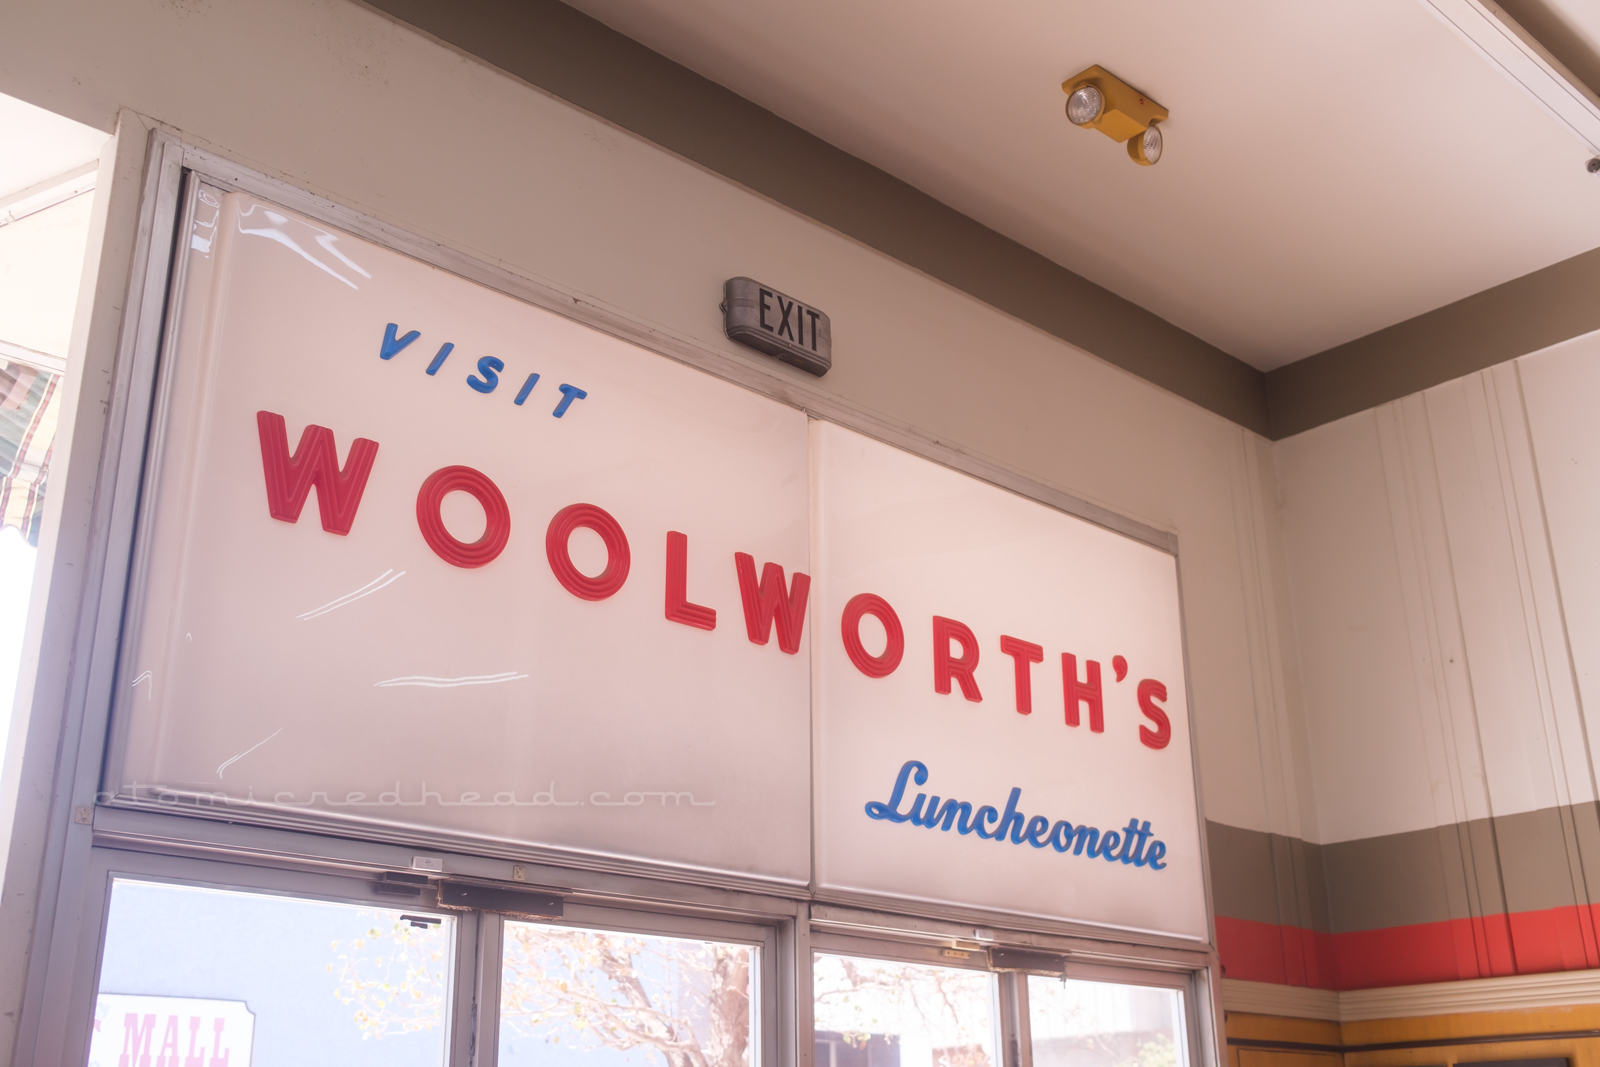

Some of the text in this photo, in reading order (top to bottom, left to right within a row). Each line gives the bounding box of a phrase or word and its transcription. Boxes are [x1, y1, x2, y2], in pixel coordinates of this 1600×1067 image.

[759, 287, 820, 352] EXIT
[379, 322, 588, 418] VISIT
[256, 410, 1172, 751] WOOLWORTH'S
[864, 760, 1168, 871] Luncheonette
[117, 1012, 231, 1067] MALL
